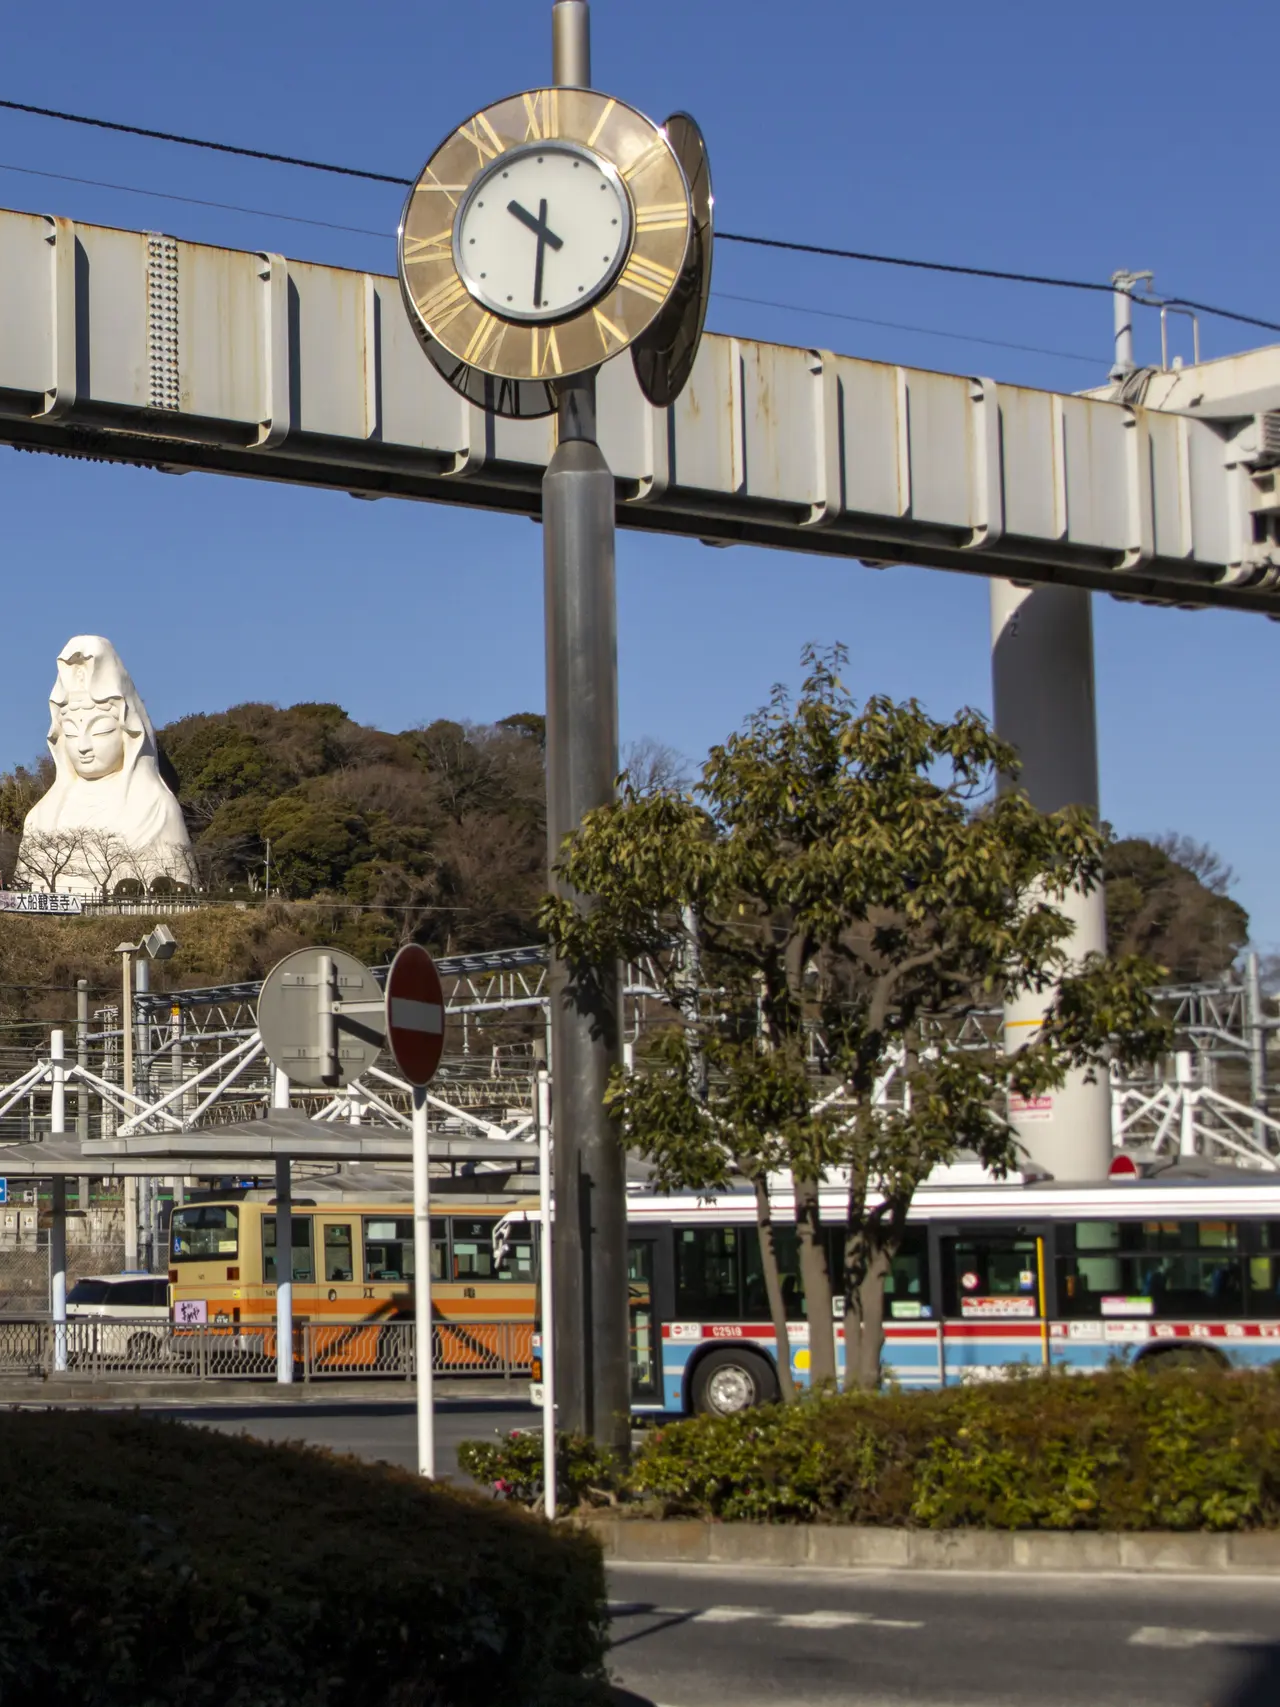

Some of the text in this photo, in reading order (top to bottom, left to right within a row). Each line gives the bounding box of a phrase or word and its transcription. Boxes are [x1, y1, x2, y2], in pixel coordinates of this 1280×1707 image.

[414, 166, 469, 208] X
[592, 307, 629, 354] V
[17, 893, 79, 911] 大船観音寺へ
